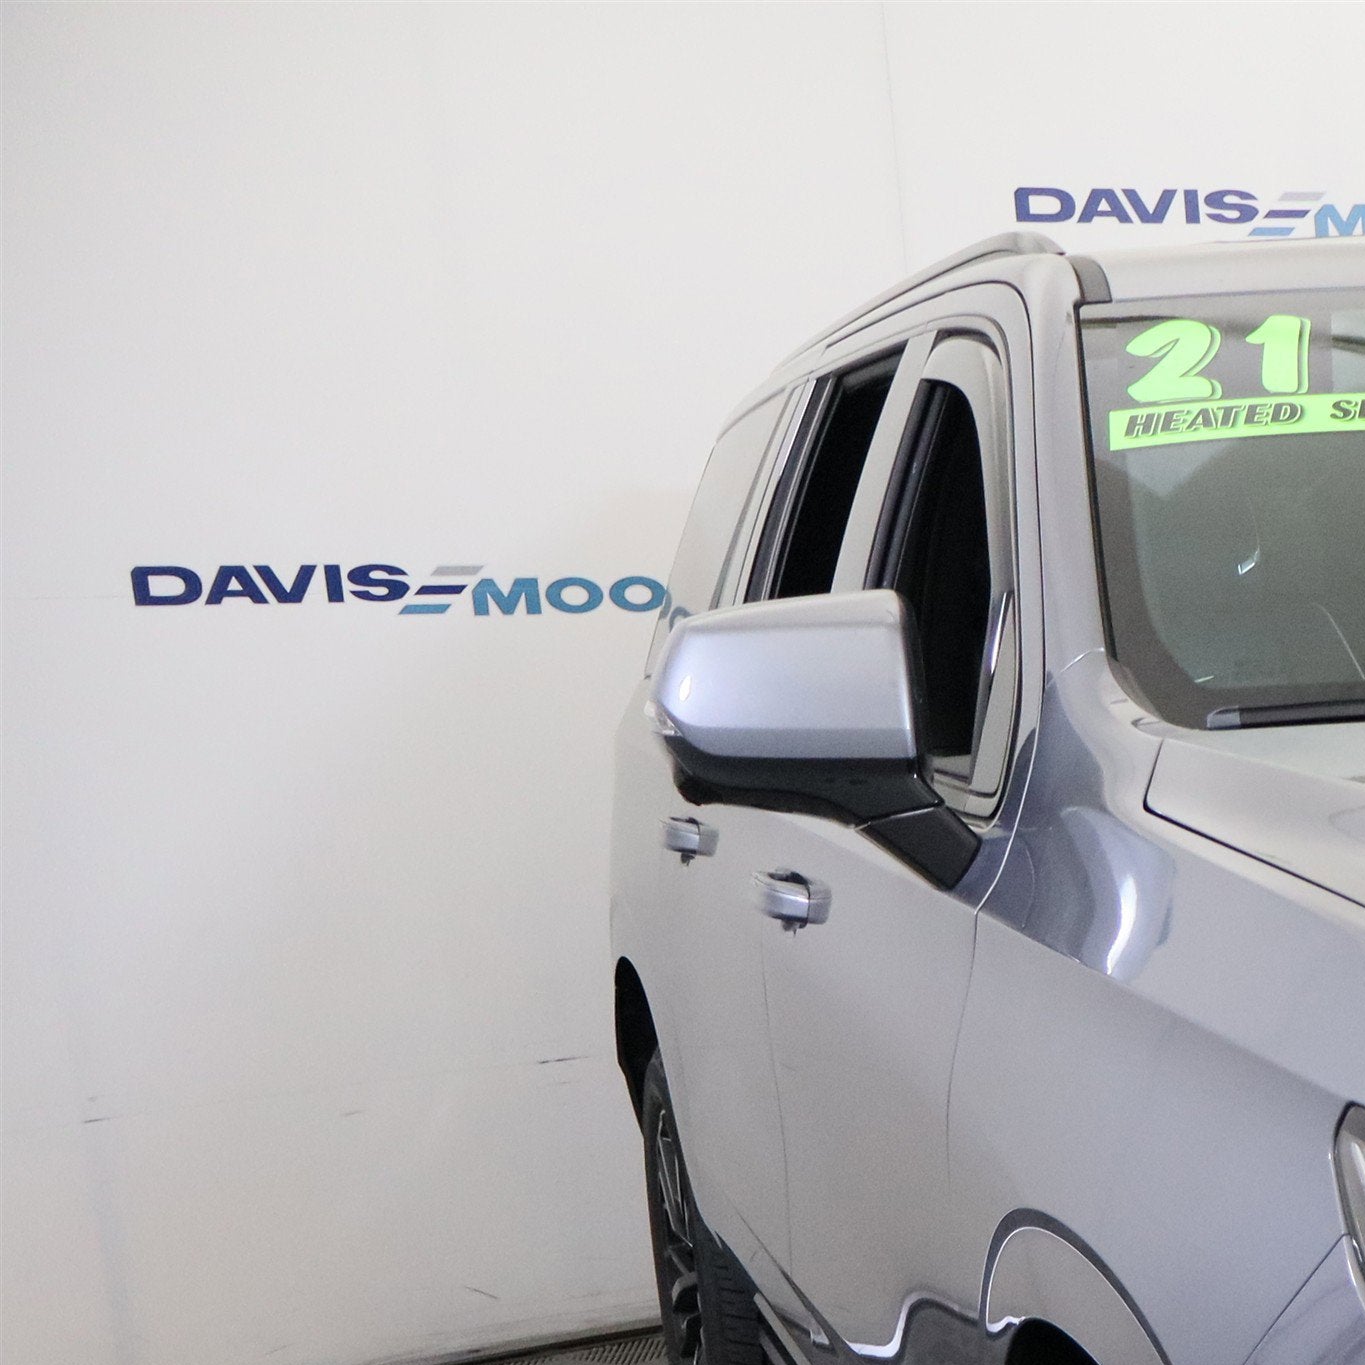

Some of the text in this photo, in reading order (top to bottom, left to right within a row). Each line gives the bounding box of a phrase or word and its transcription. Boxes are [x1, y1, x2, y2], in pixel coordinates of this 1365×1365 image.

[1014, 186, 1260, 224] DAVIS
[1125, 314, 1311, 402] 21
[1123, 402, 1304, 438] HEATED
[131, 564, 411, 605] DAVIS
